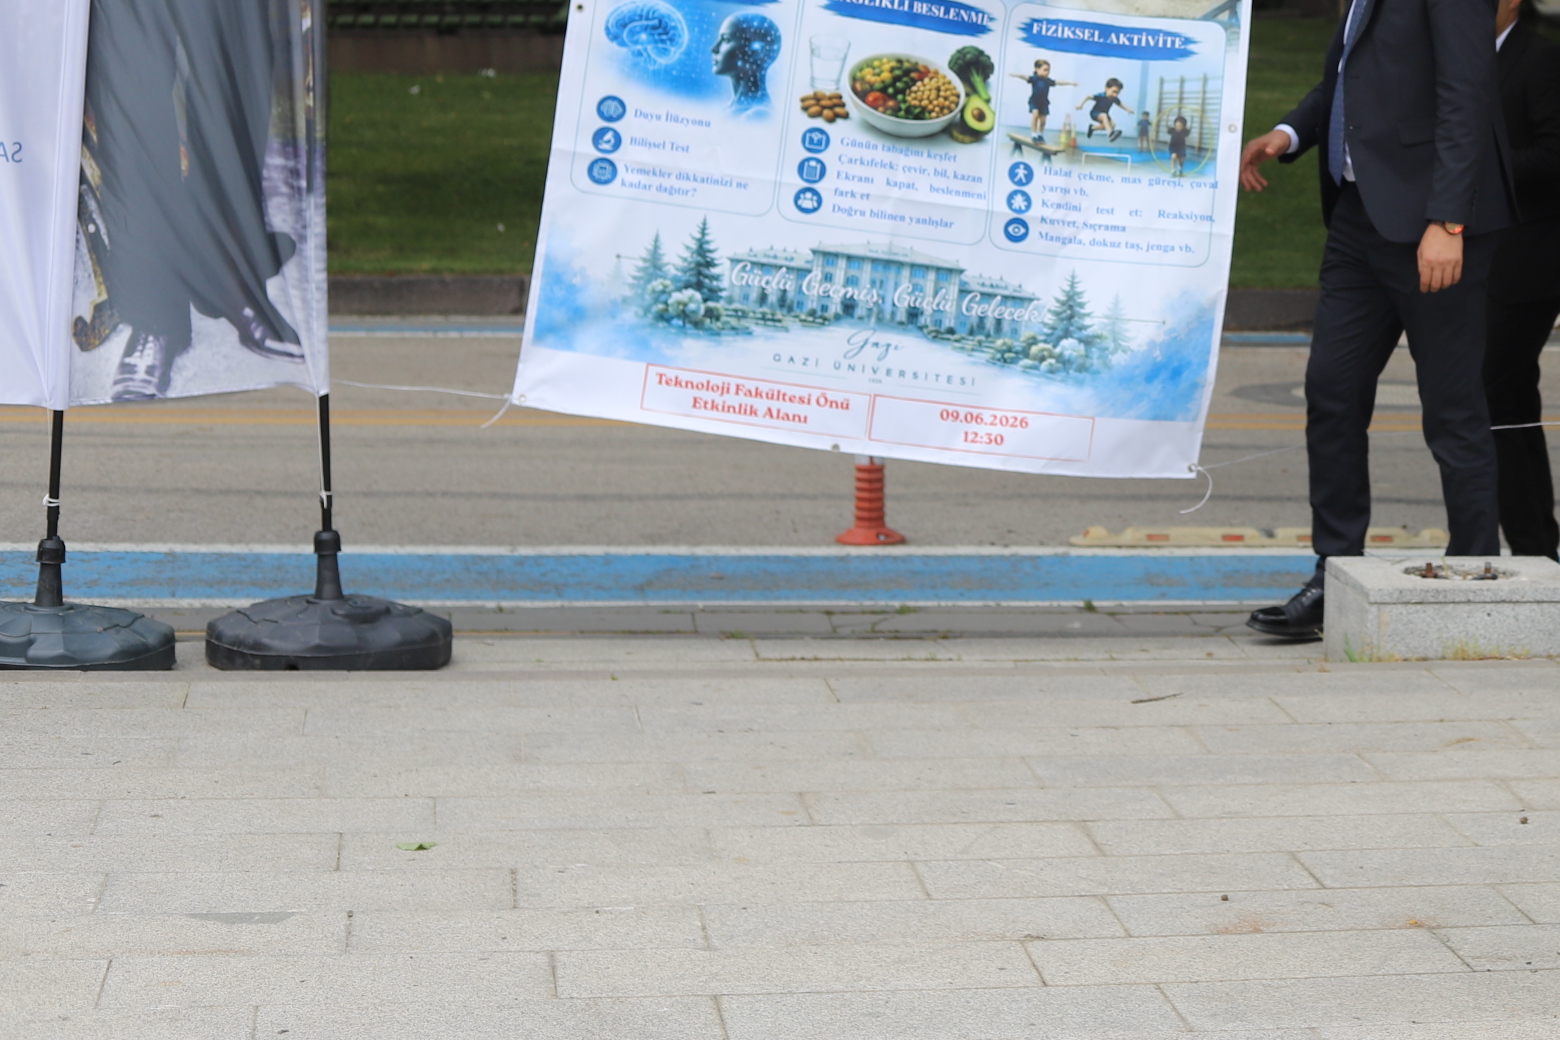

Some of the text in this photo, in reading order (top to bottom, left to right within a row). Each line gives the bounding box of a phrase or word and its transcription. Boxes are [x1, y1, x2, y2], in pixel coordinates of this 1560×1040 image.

[1032, 21, 1185, 50] FİZİKSEL AKTİVİTE
[634, 108, 712, 129] Duyu İlüzyonu
[629, 135, 690, 154] Bilişsel Test
[840, 136, 957, 165] Günün tabağını keşfet
[624, 163, 749, 191] Yemekler dikkatinizi ne
[836, 170, 874, 185] Ekranı
[929, 183, 987, 201] beslenmeni
[952, 172, 983, 184] kazan
[1043, 166, 1072, 179] Halat
[1120, 175, 1142, 184] mas
[1189, 179, 1218, 190] çuval
[620, 178, 698, 199] kadar dağıtır?
[834, 187, 871, 201] fark et
[1041, 184, 1089, 198] yarışı vb.
[832, 203, 954, 229] Doğru bilinen yanlışlar
[1041, 199, 1082, 213] Kendini
[1096, 205, 1115, 216] test
[1129, 207, 1143, 217] et:
[1083, 221, 1127, 235] Sıçrama
[1089, 237, 1122, 250] dokuz
[1146, 242, 1175, 254] jenga
[1179, 244, 1195, 254] vb.
[731, 262, 794, 294] Güçlü
[894, 283, 954, 315] Güçlü
[773, 352, 976, 388] GAZİ ÜNİVERSİTESİ
[656, 371, 850, 411] Teknoloji Fakültesi Önü
[692, 395, 808, 424] Etkinlik Alanı
[939, 408, 1029, 430] 09.06.2026
[963, 431, 1004, 447] 12:30
